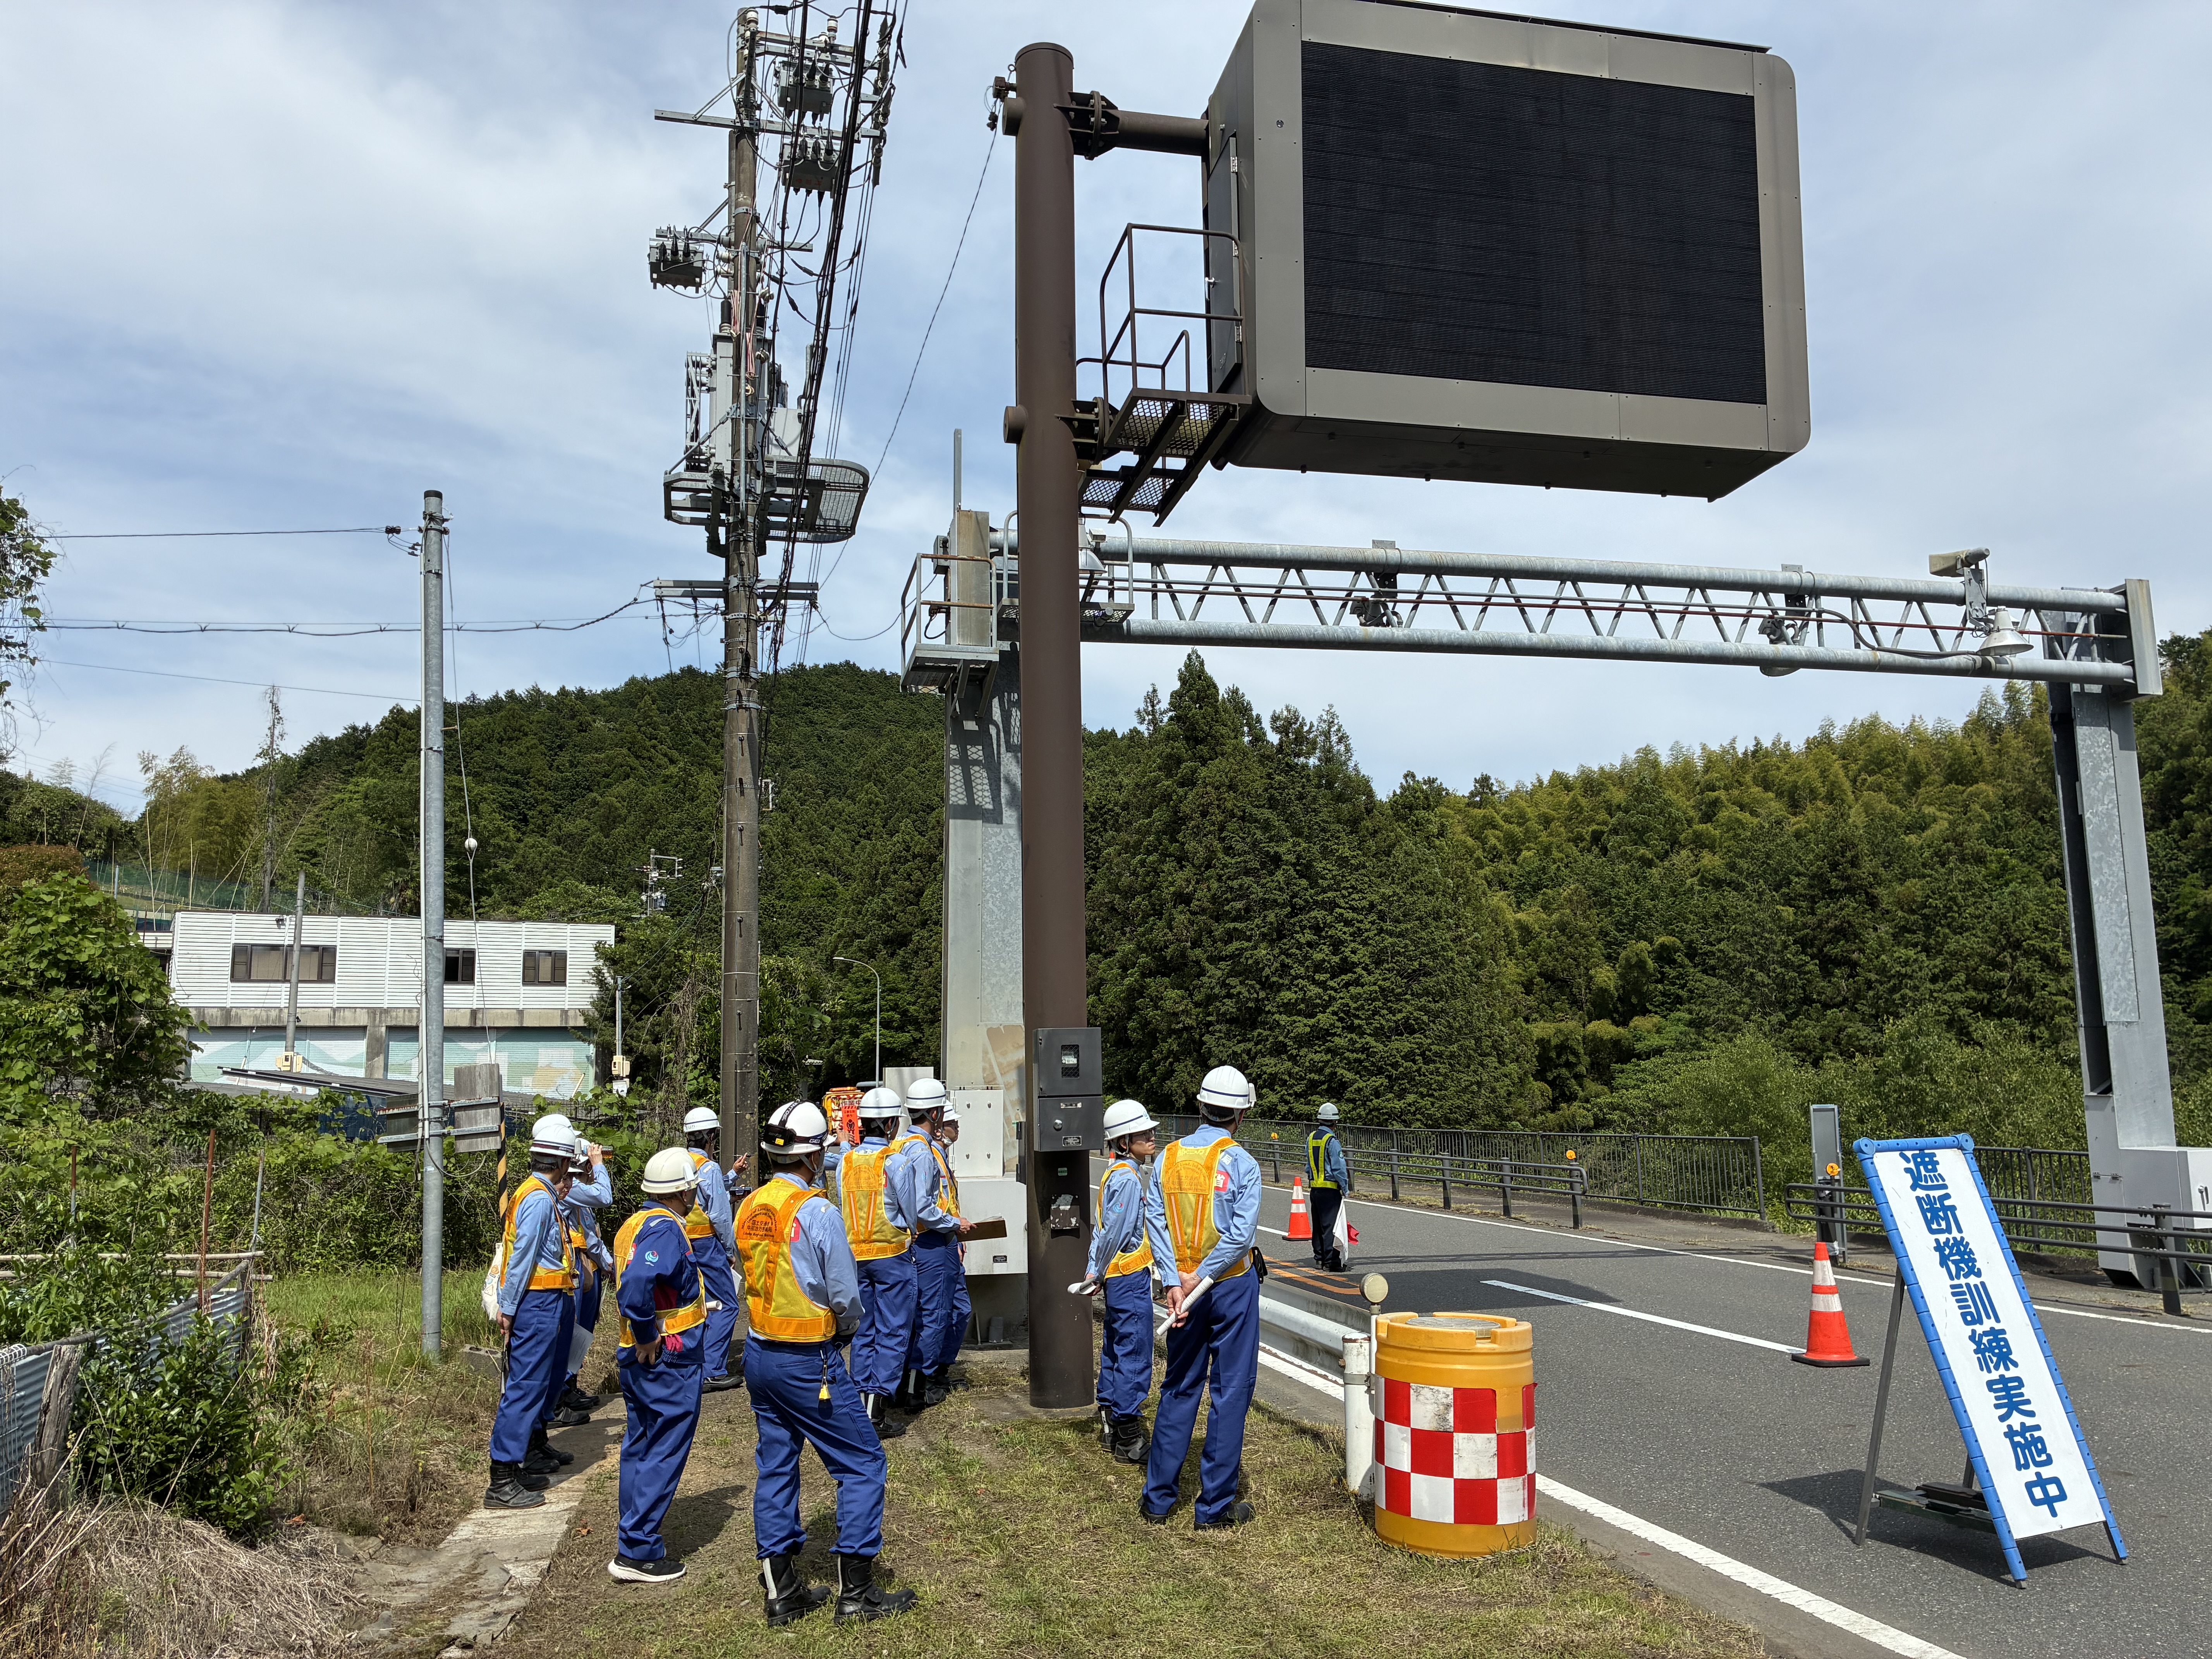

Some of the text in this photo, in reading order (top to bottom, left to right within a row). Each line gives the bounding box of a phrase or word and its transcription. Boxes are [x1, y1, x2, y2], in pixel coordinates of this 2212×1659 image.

[1899, 1150, 2068, 1518] 遮断機訓練実施中
